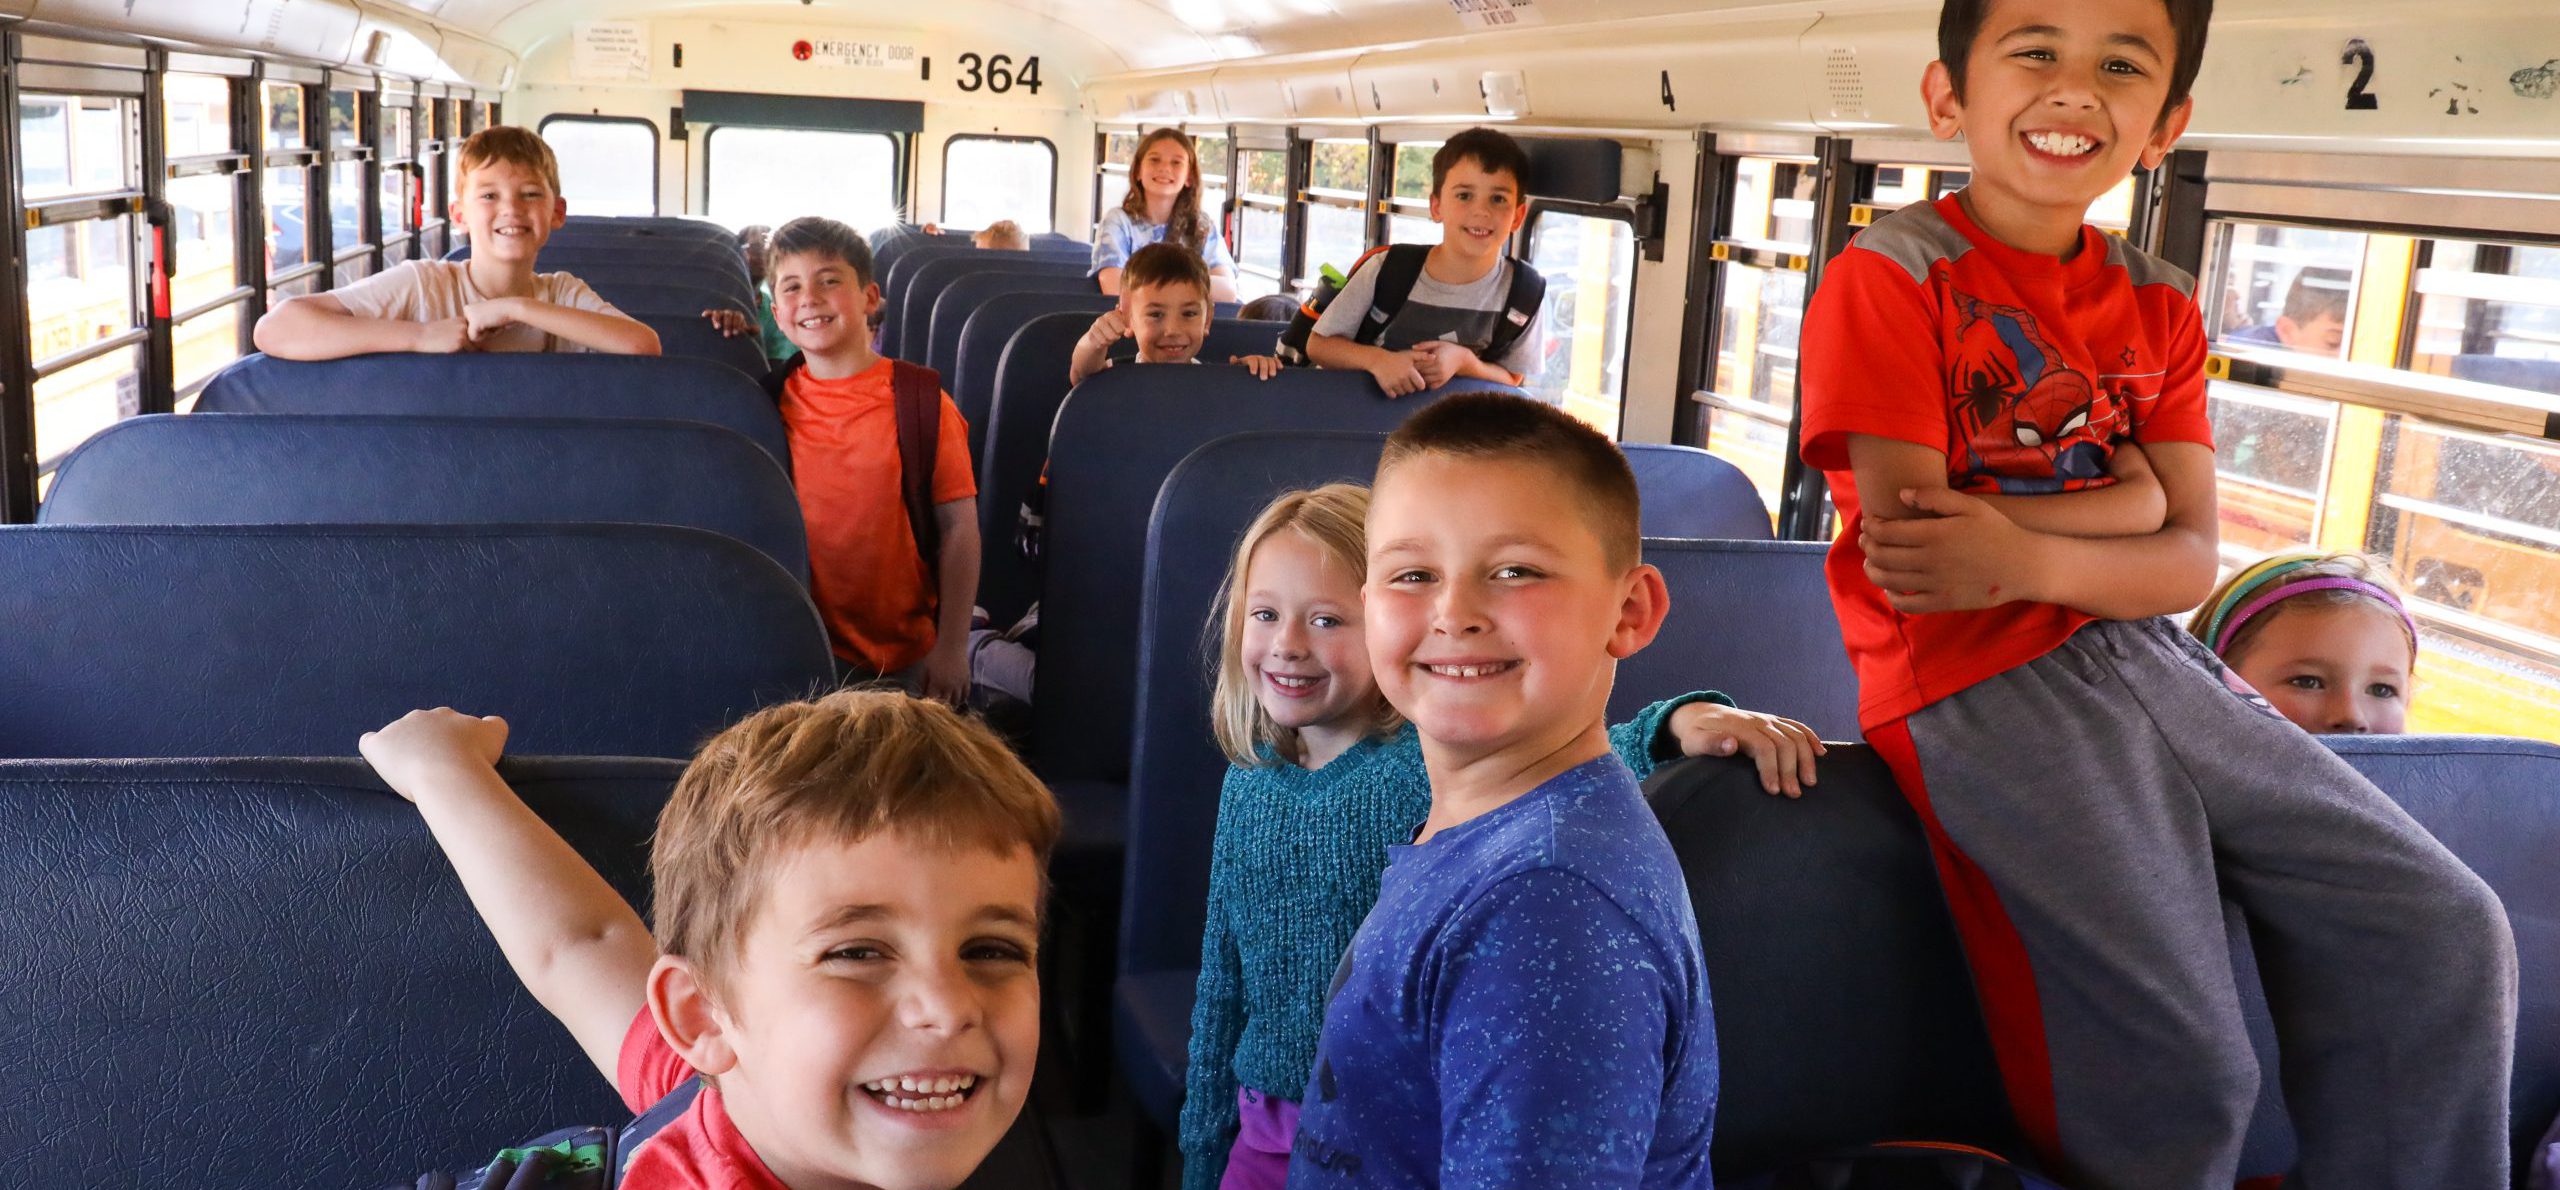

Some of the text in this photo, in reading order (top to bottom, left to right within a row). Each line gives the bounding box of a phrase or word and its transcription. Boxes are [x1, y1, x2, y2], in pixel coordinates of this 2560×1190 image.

[815, 40, 914, 60] EMERGENCY DOOR
[957, 52, 1042, 94] 364
[1661, 70, 1675, 111] 4
[2342, 38, 2378, 110] 2
